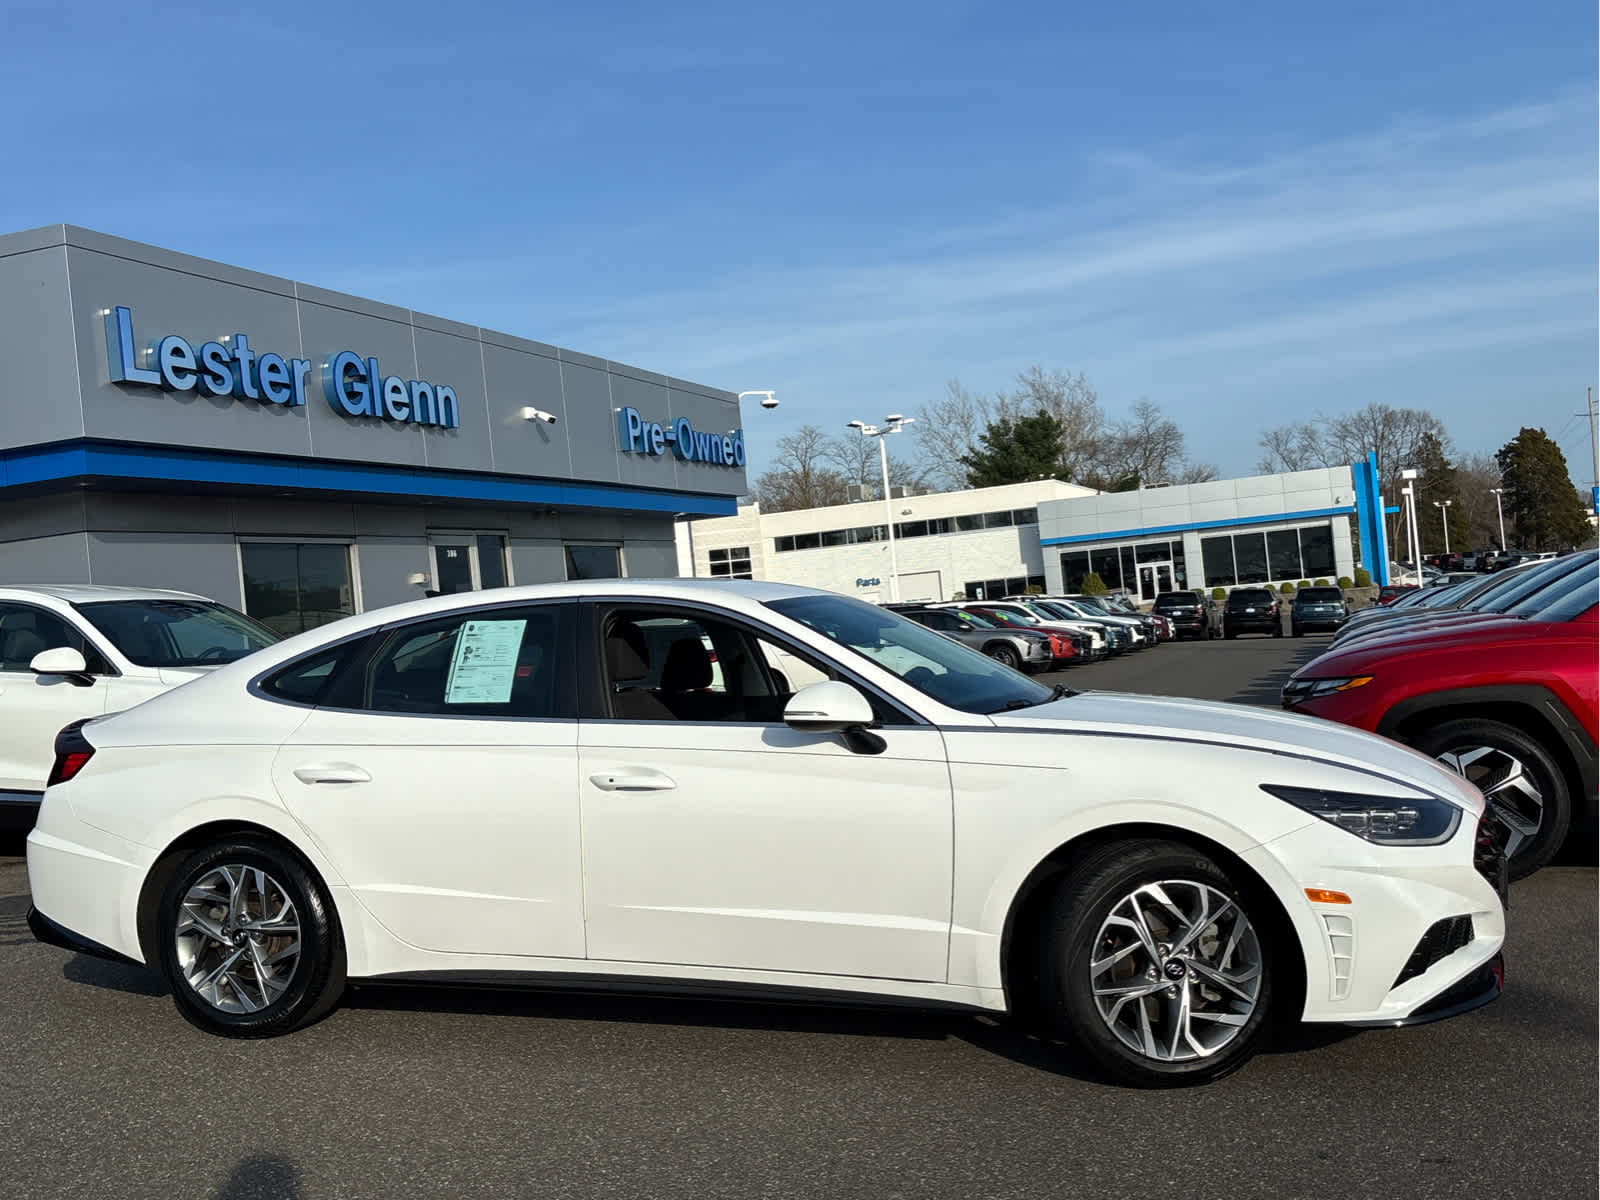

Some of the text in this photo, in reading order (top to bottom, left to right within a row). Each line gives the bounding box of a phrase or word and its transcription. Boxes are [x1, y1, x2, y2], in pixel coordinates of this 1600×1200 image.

[113, 306, 459, 428] Lester Glenn
[622, 406, 745, 467] Pre-Owned
[856, 577, 880, 587] Parts
